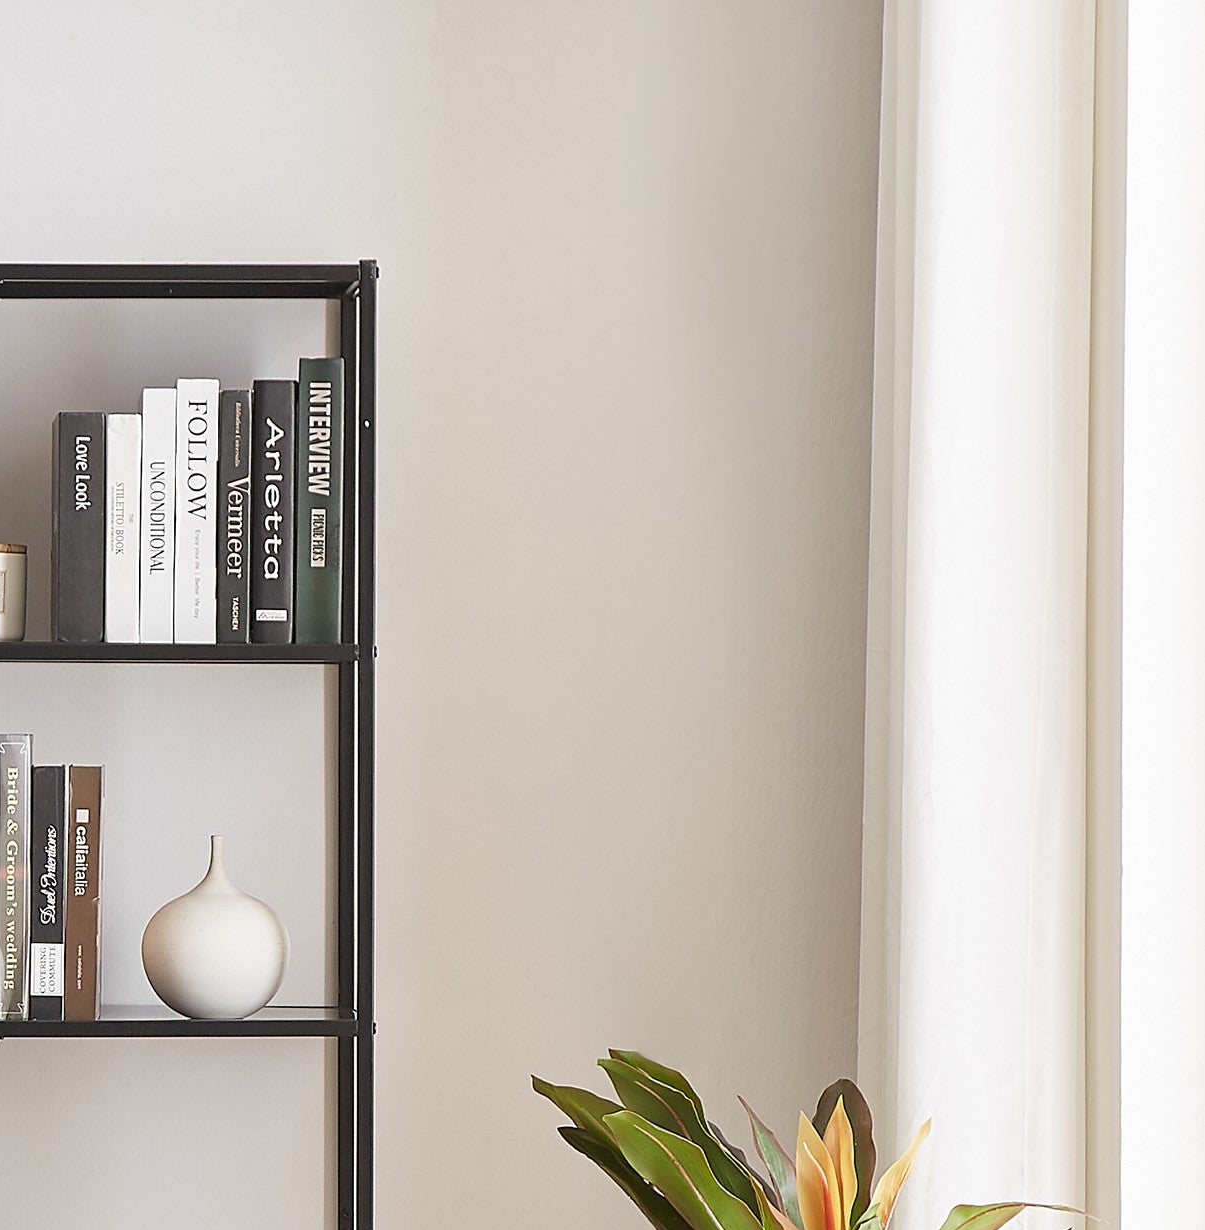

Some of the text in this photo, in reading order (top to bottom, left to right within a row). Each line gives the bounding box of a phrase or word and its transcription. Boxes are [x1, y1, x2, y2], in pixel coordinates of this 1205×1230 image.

[75, 436, 92, 511] Love Look
[187, 400, 208, 521] FOLLOW
[308, 382, 332, 496] INTERVIEW
[115, 482, 125, 555] STILETTO BOOK
[149, 462, 166, 575] UNCONDITIONAL
[227, 477, 250, 579] Vermeer
[263, 418, 284, 580] Arletta
[231, 597, 239, 630] TASCHEN
[3, 766, 19, 990] Bride & Groom's wedding
[40, 824, 57, 925] Duel Intentions
[74, 825, 89, 896] caliaitalia
[39, 946, 47, 994] COVERING
[48, 945, 57, 993] COMMUTE
